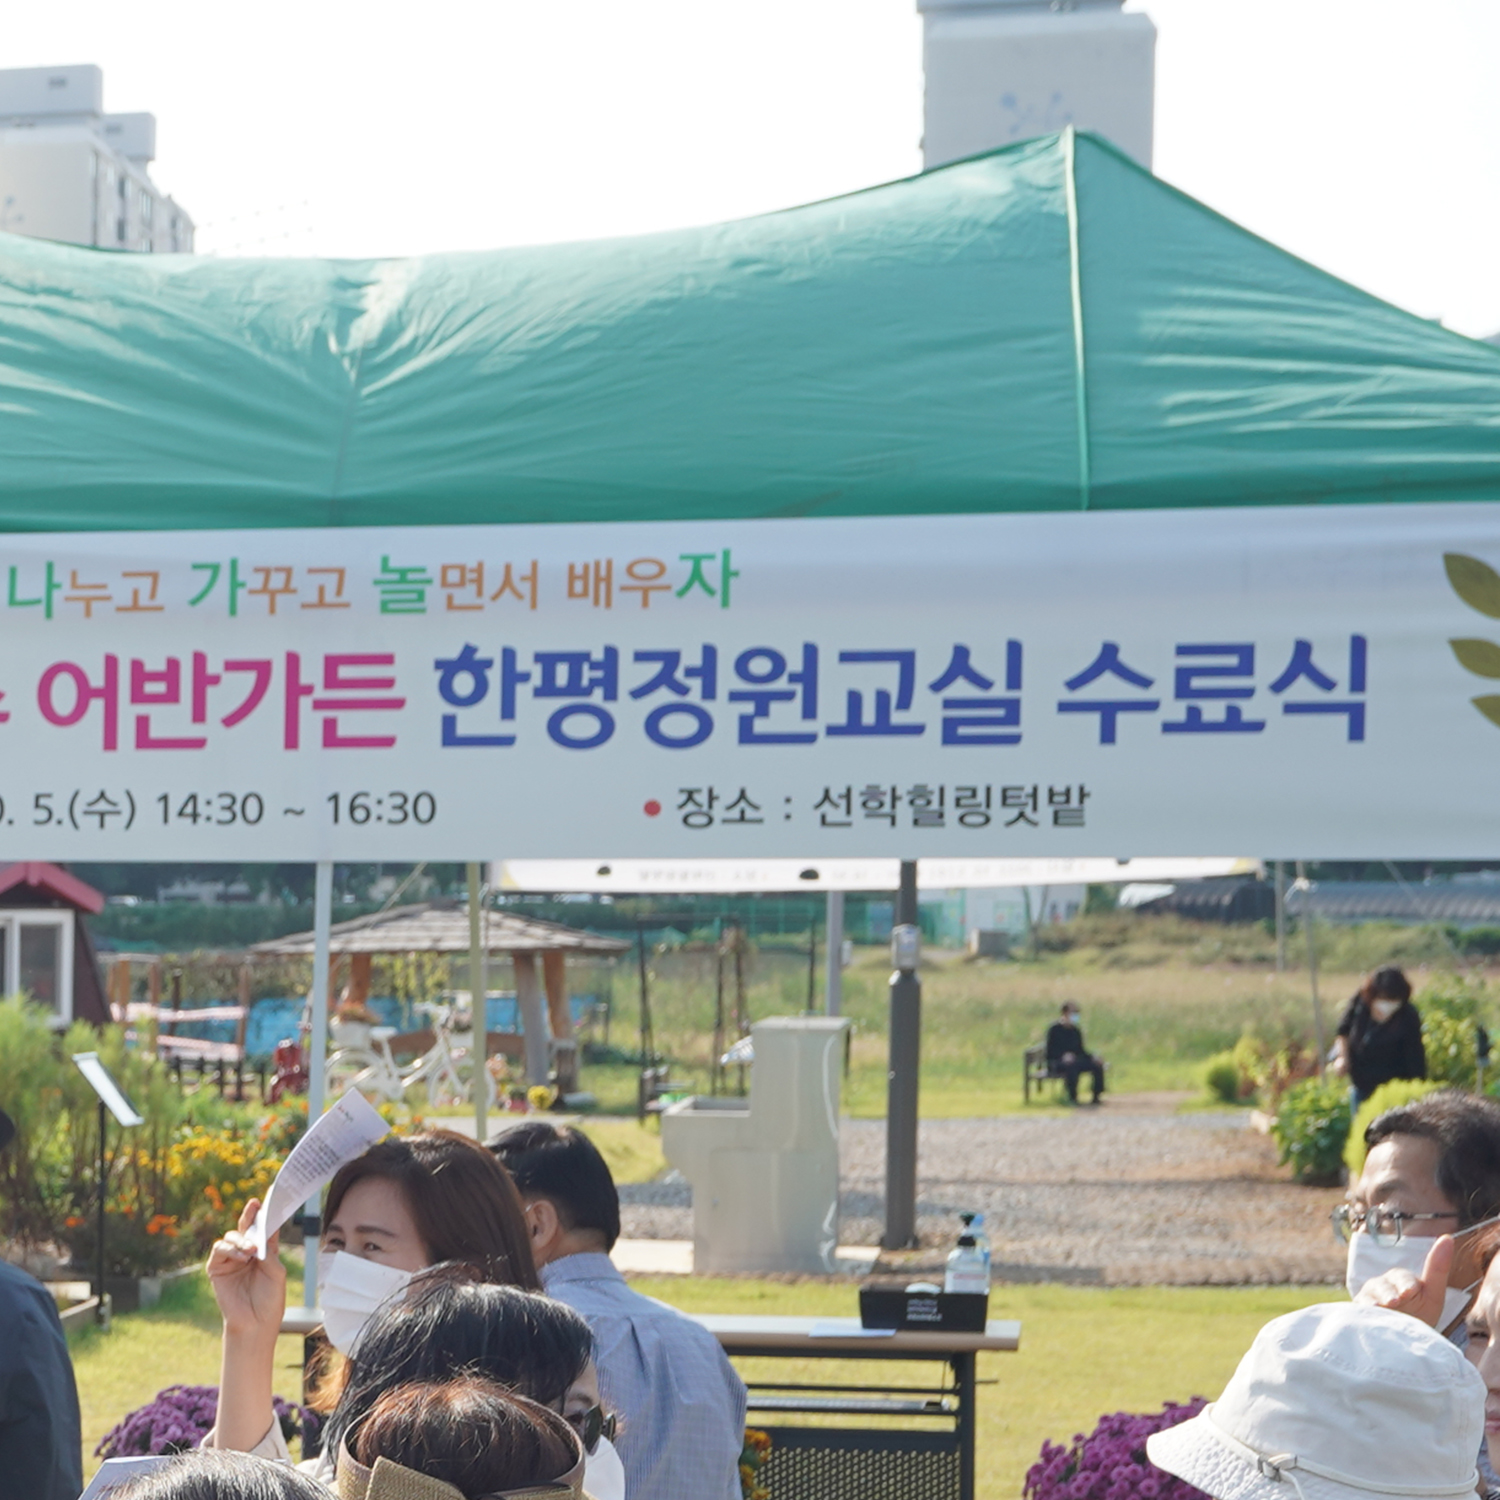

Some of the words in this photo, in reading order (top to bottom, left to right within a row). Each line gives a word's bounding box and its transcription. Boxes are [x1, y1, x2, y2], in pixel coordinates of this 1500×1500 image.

[8, 561, 165, 619] 나누고
[188, 557, 351, 617] 가꾸고
[373, 554, 538, 614] 놀면서
[567, 548, 740, 609] 배우자
[37, 650, 405, 752] 어반가든
[434, 640, 1023, 750] 한평정원교실
[1057, 633, 1368, 746] 수료식
[33, 789, 136, 830] 5.(수)
[157, 792, 264, 825] 14:30
[327, 792, 437, 825] 16:30
[677, 786, 764, 829] 장소
[813, 784, 1090, 828] 선학힐링텃밭
